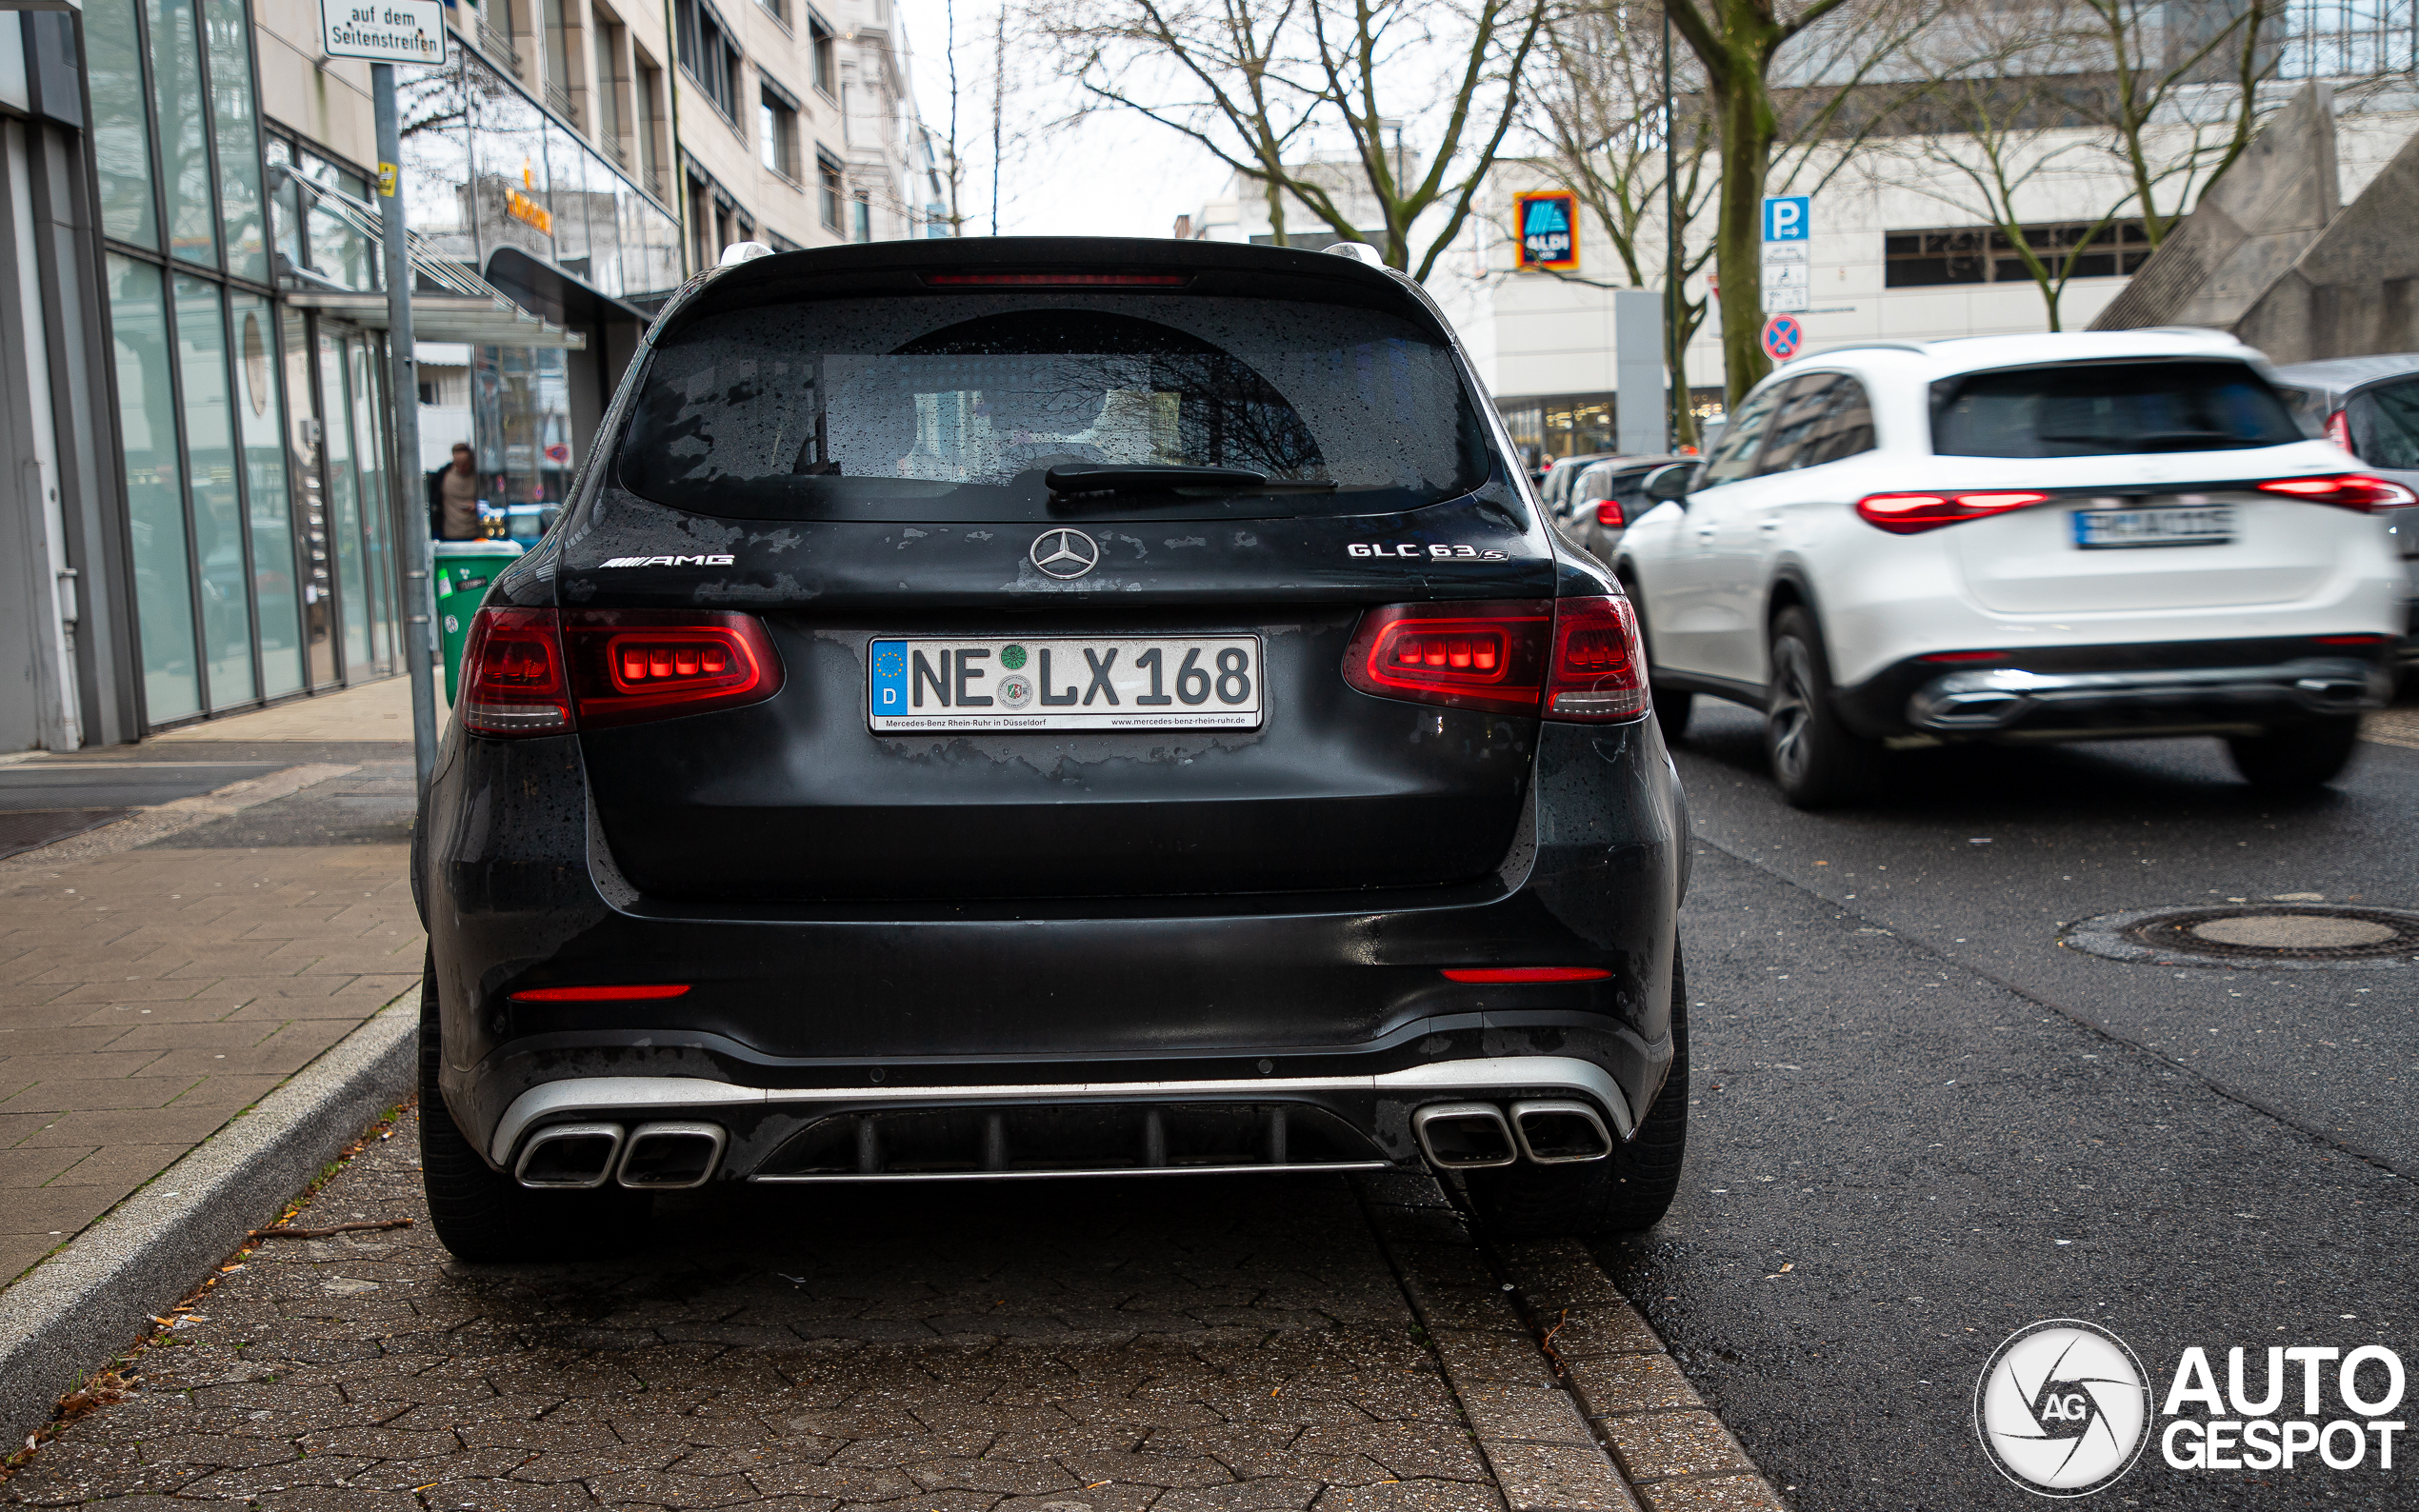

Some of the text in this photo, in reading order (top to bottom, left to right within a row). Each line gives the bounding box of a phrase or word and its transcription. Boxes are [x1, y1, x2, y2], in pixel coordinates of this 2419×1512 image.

[351, 6, 415, 26] auf dem
[332, 25, 436, 51] Seitenstreifen
[1772, 201, 1801, 240] P
[1526, 233, 1569, 251] ALDI
[1348, 544, 1420, 558] GLC
[912, 648, 993, 707] NE
[1040, 648, 1120, 706] LX
[1135, 647, 1251, 706] 168
[883, 687, 896, 705] D
[886, 719, 946, 727] Mercedes-Benz
[1003, 718, 1047, 726] Düsseldorf
[1111, 717, 1246, 726] www.mercedes-benz-rhein-ruhr.de
